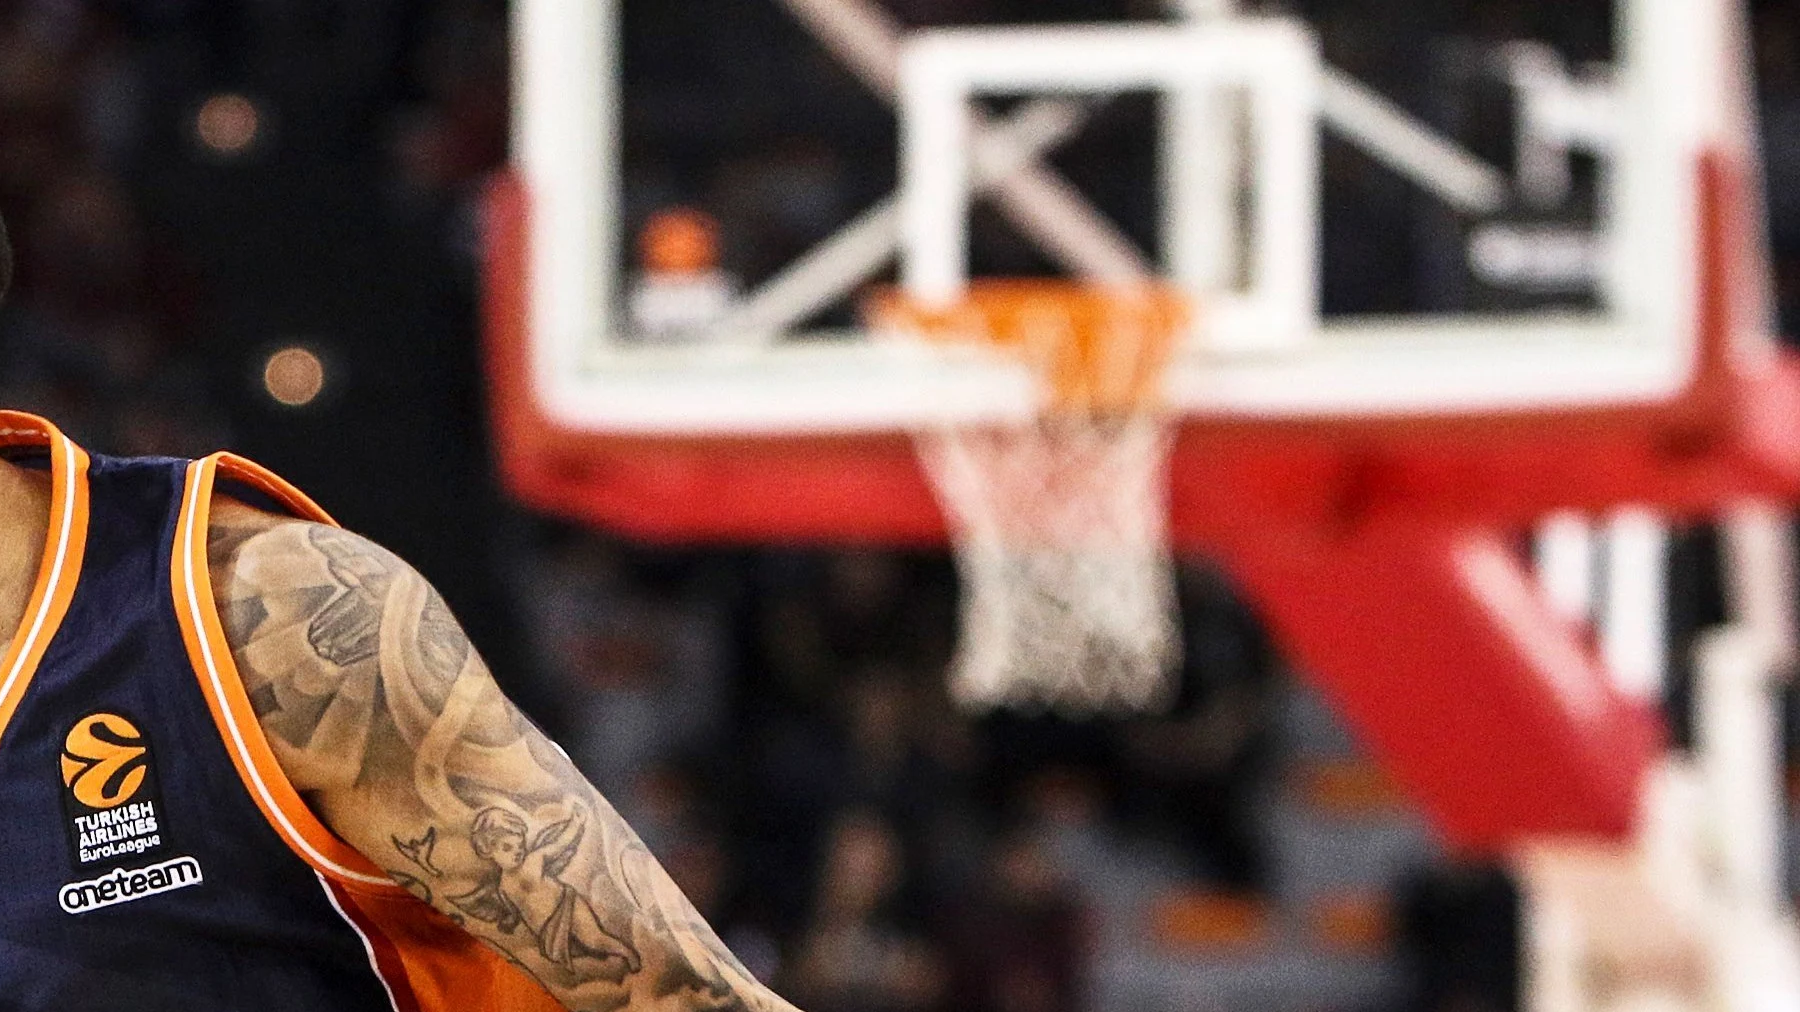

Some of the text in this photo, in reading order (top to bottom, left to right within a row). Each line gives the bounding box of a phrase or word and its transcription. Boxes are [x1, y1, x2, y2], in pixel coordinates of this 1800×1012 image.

[75, 800, 154, 832] TURKISH
[79, 817, 157, 849] AIRLINES
[80, 834, 161, 863] EuroLeague
[63, 861, 198, 909] oneteam
